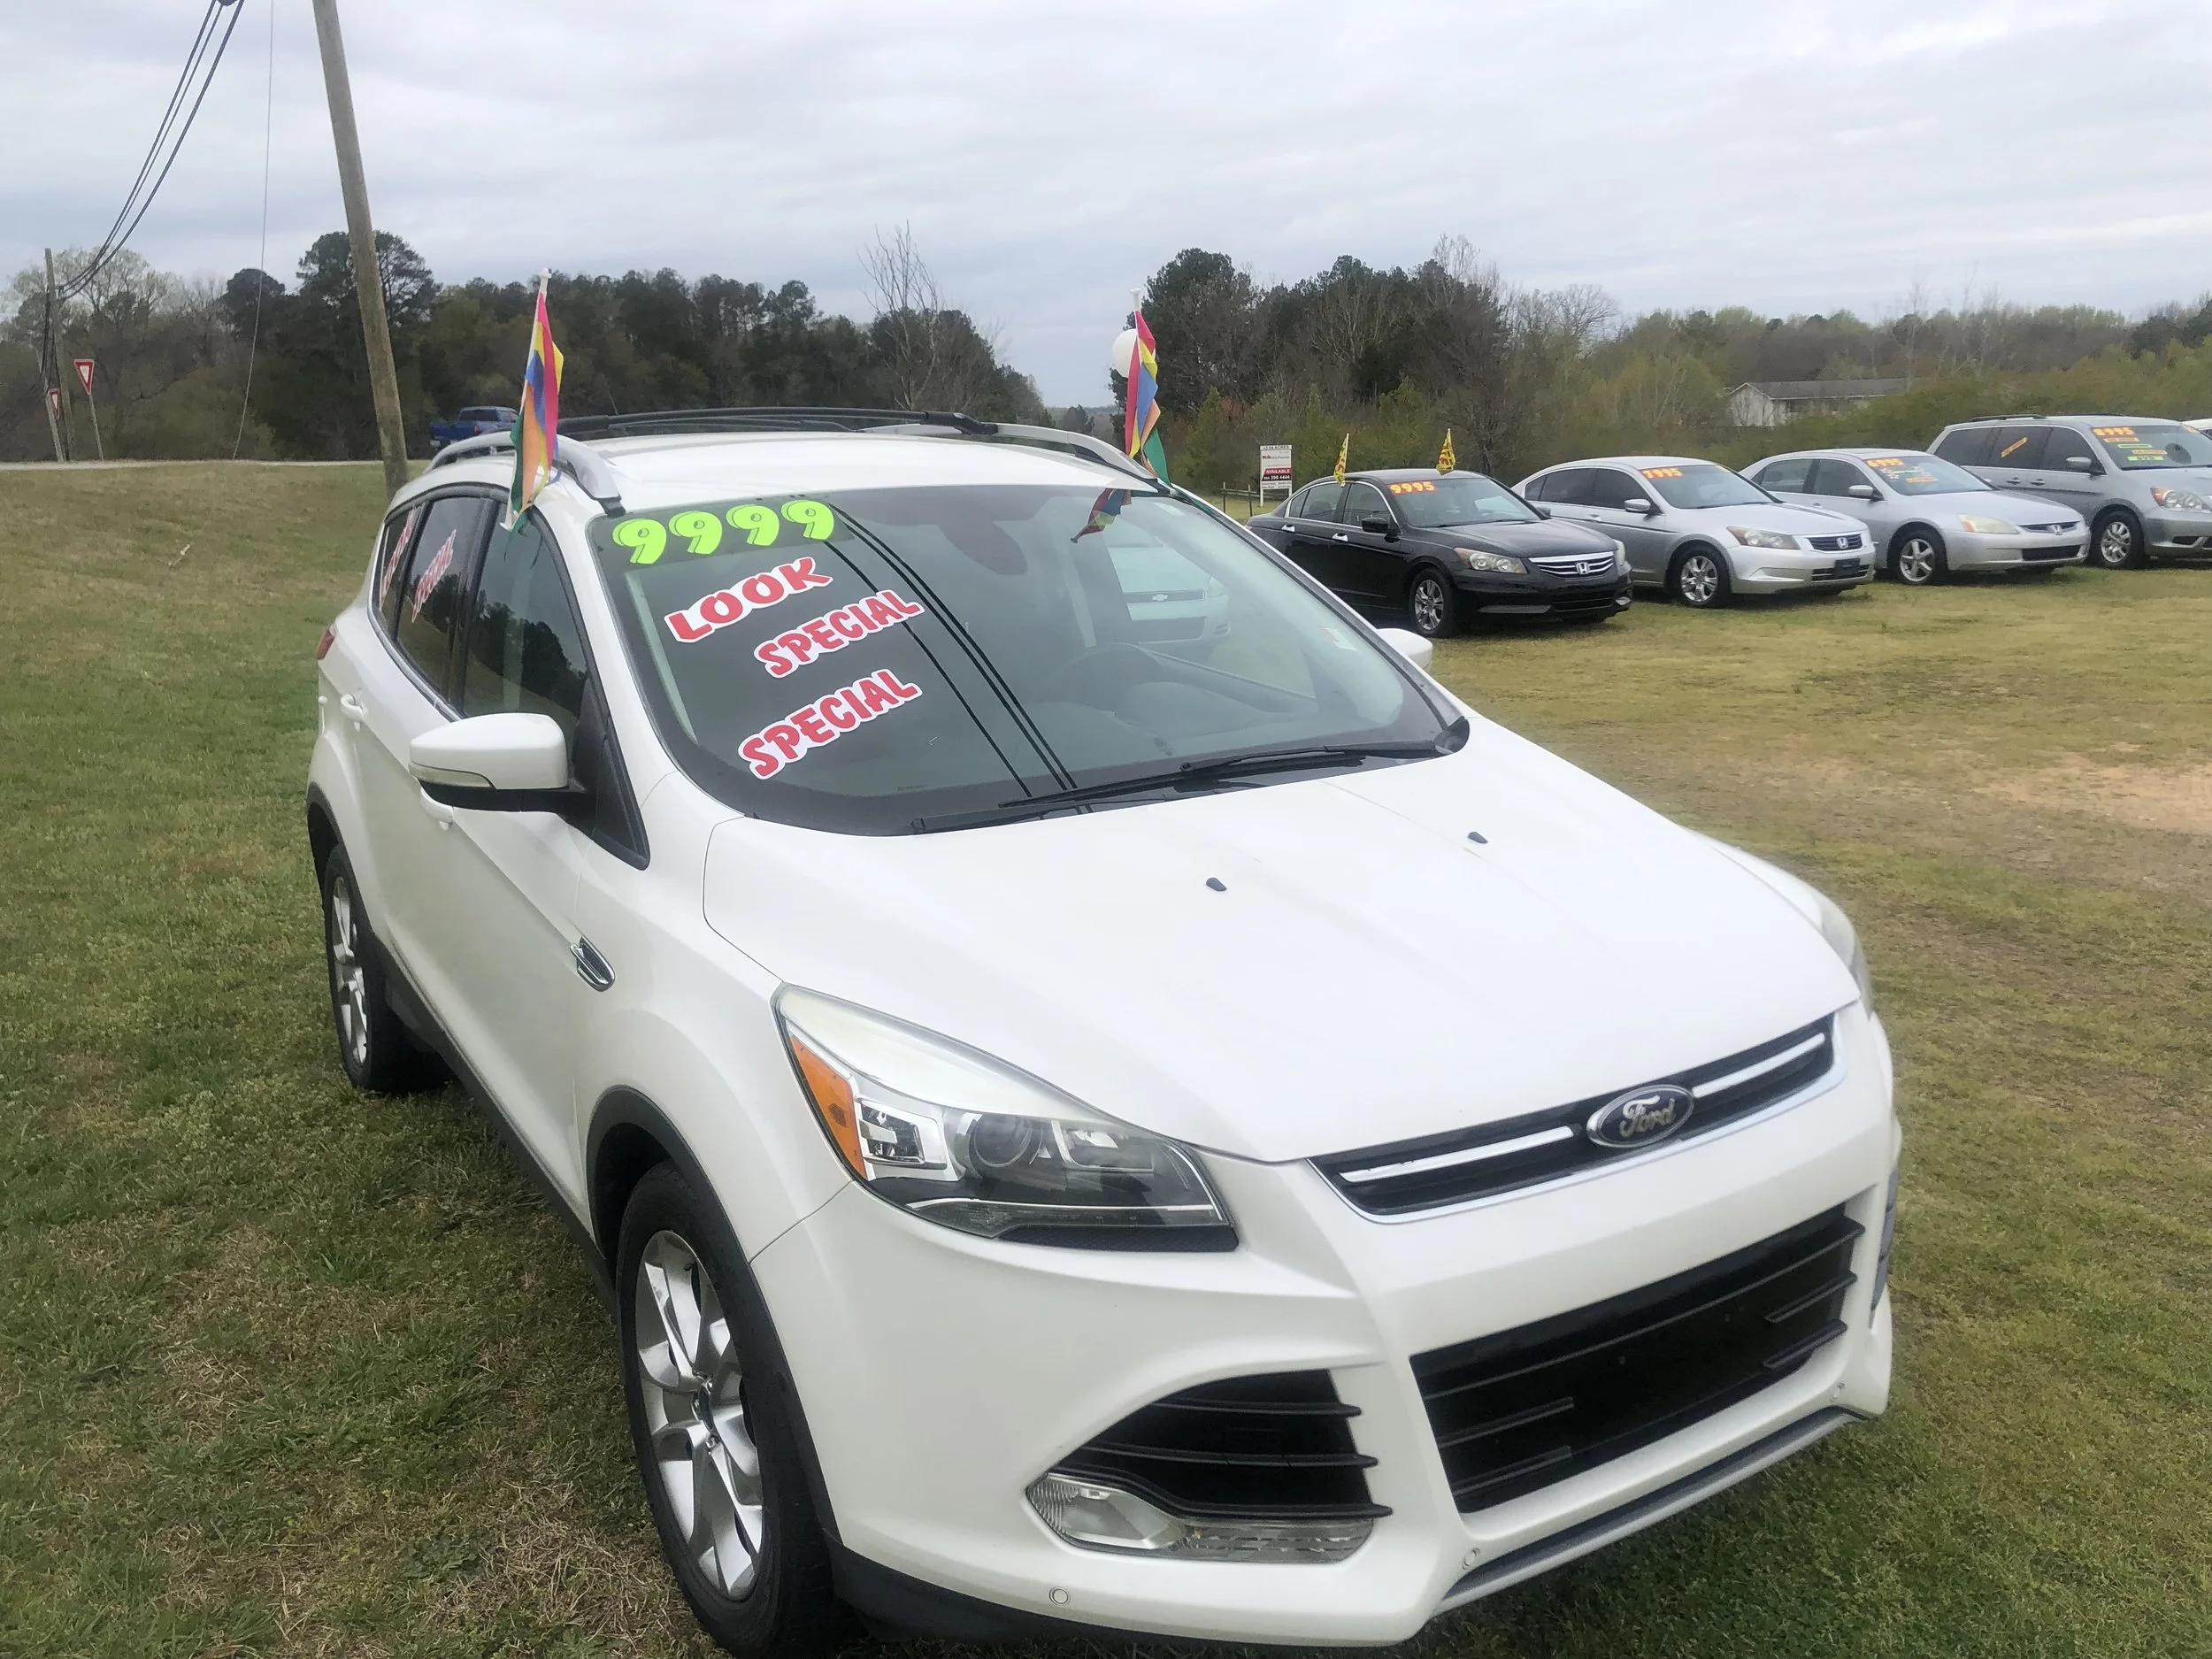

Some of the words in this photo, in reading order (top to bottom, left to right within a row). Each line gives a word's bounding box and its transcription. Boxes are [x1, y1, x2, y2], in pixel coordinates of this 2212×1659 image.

[1388, 480, 1436, 495] 9995
[611, 500, 834, 565] 9999
[666, 557, 832, 642] LOOK
[755, 590, 924, 678] SPECIAL
[739, 669, 921, 780] SPECIAL
[1619, 1094, 1676, 1137] Ford
